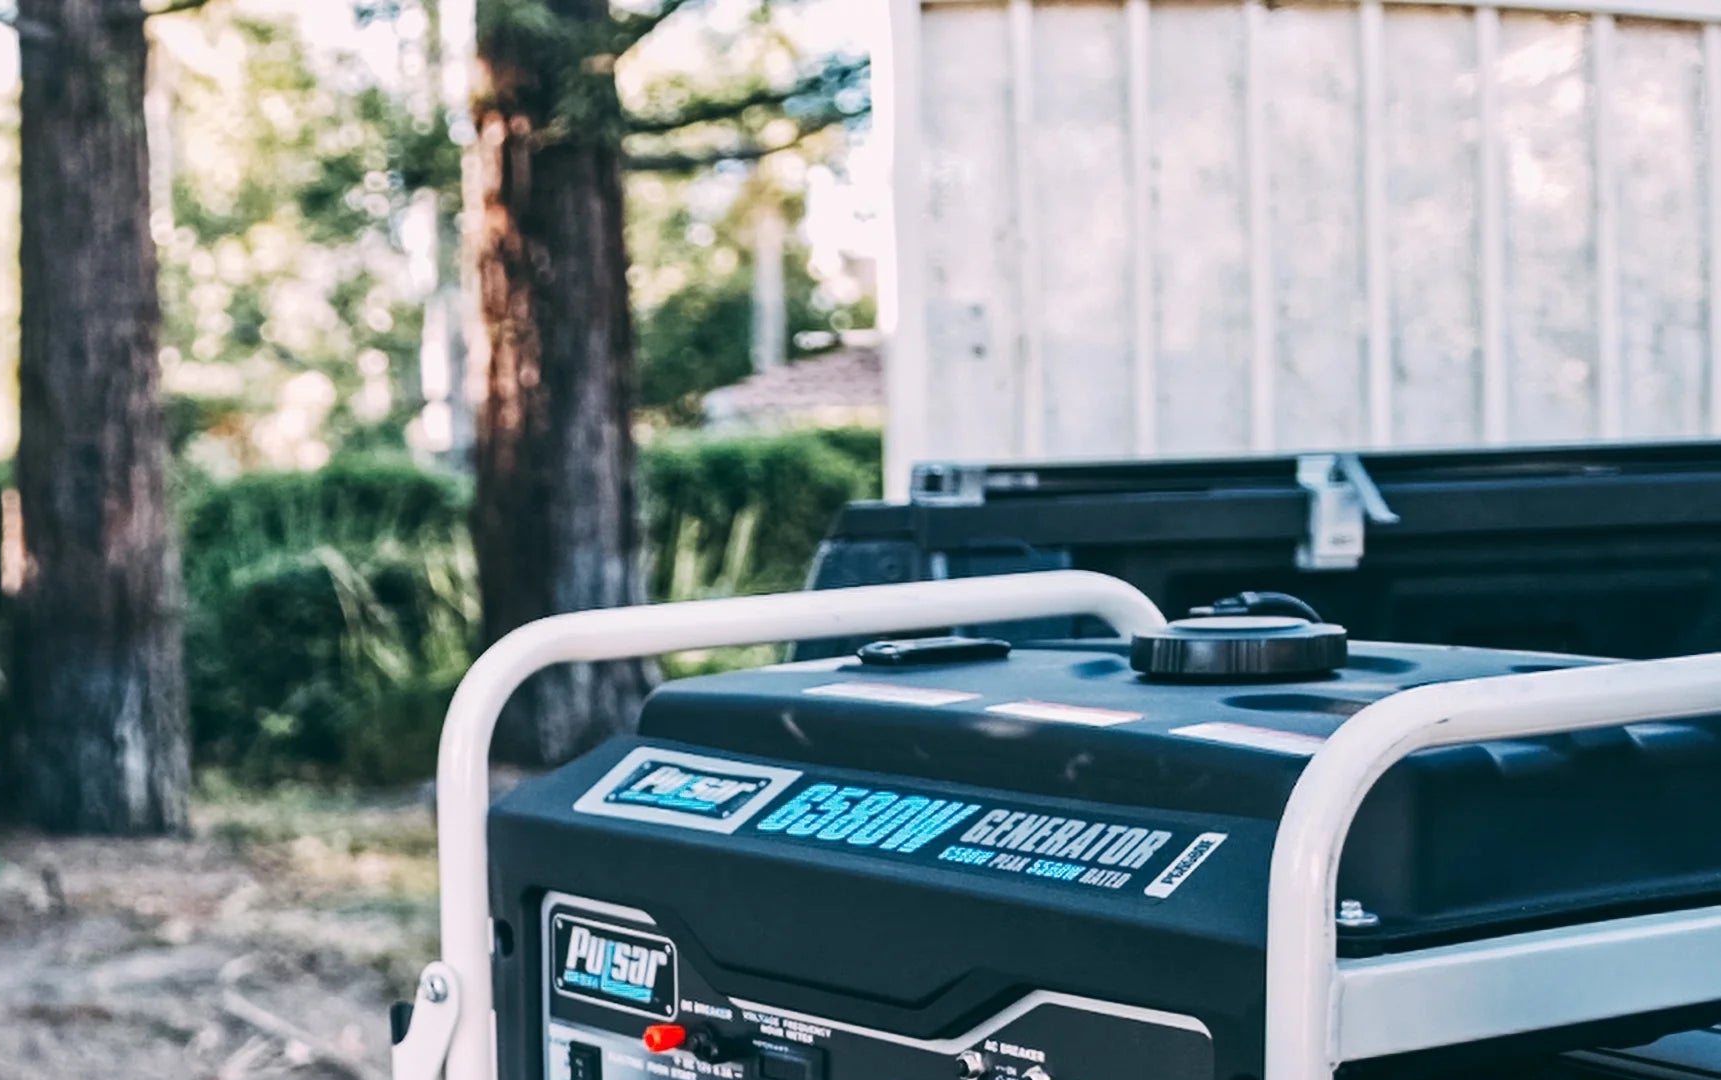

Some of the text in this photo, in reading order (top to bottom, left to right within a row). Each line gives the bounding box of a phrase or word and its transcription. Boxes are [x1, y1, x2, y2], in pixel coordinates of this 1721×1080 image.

[757, 783, 1174, 870] 6580W GENERATOR
[988, 852, 1031, 873] PEAK
[1078, 867, 1132, 889] RATED
[564, 925, 669, 1003] Pulsar
[1000, 1042, 1046, 1063] BREAKER
